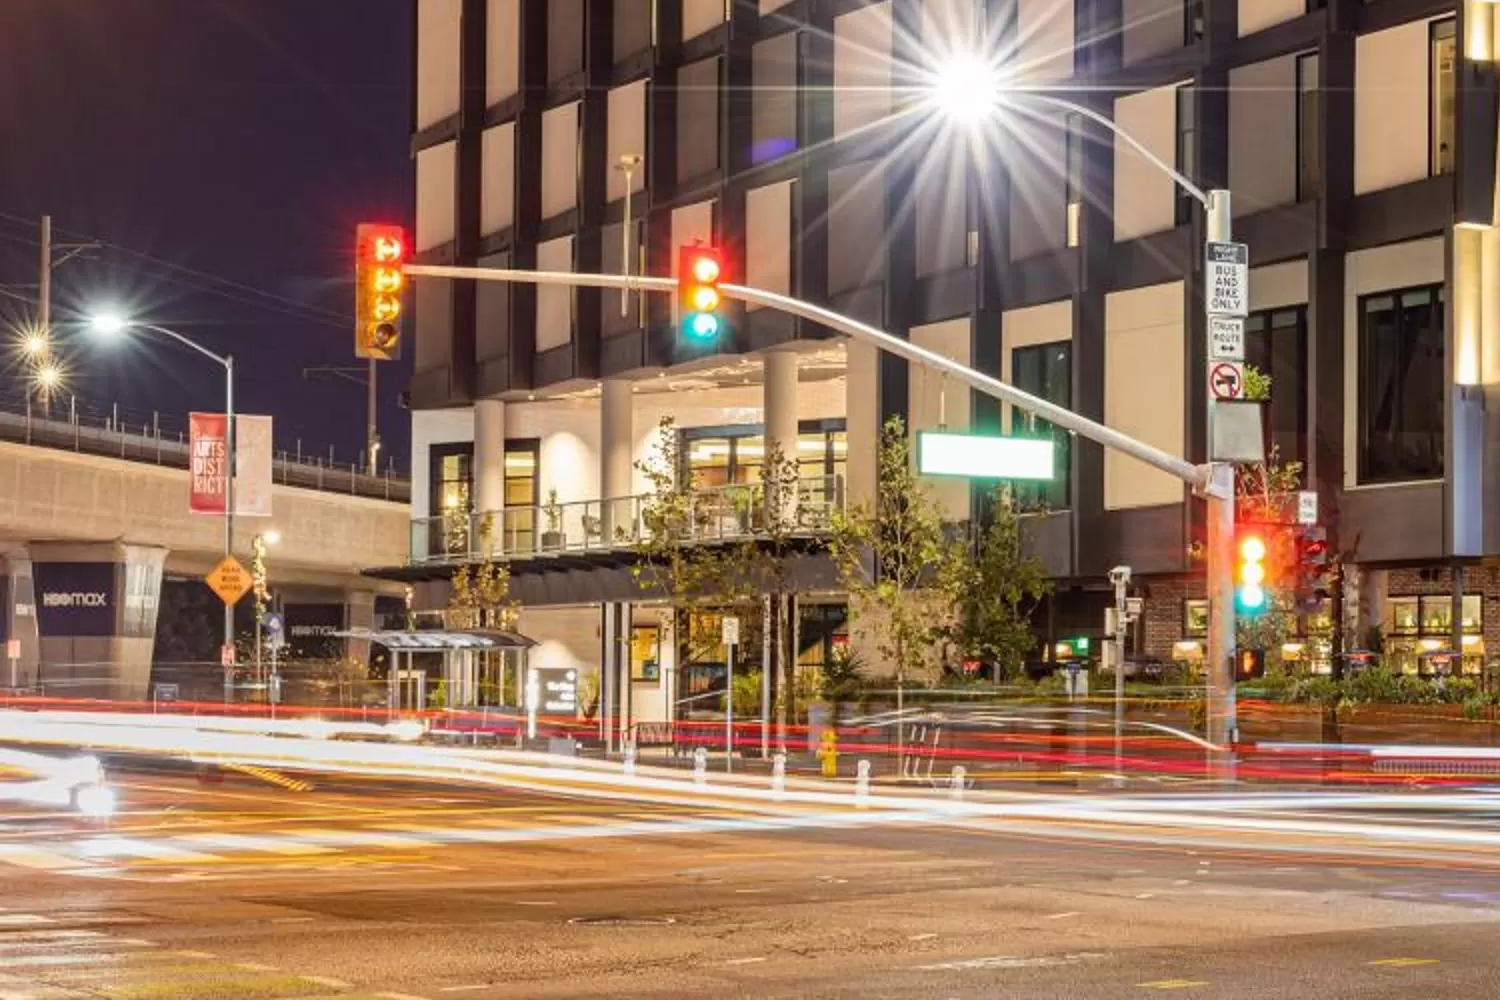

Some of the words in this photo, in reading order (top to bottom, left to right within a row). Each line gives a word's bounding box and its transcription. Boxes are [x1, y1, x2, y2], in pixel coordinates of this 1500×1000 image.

[1215, 265, 1237, 276] BUS
[1215, 277, 1239, 287] AND
[1215, 287, 1240, 298] BIKE
[1211, 298, 1241, 309] ONLY
[1212, 321, 1240, 331] TRUCK
[1213, 332, 1239, 343] ROUTE
[193, 440, 225, 457] ARTS
[193, 457, 225, 475] DIST
[193, 475, 225, 494] RICT
